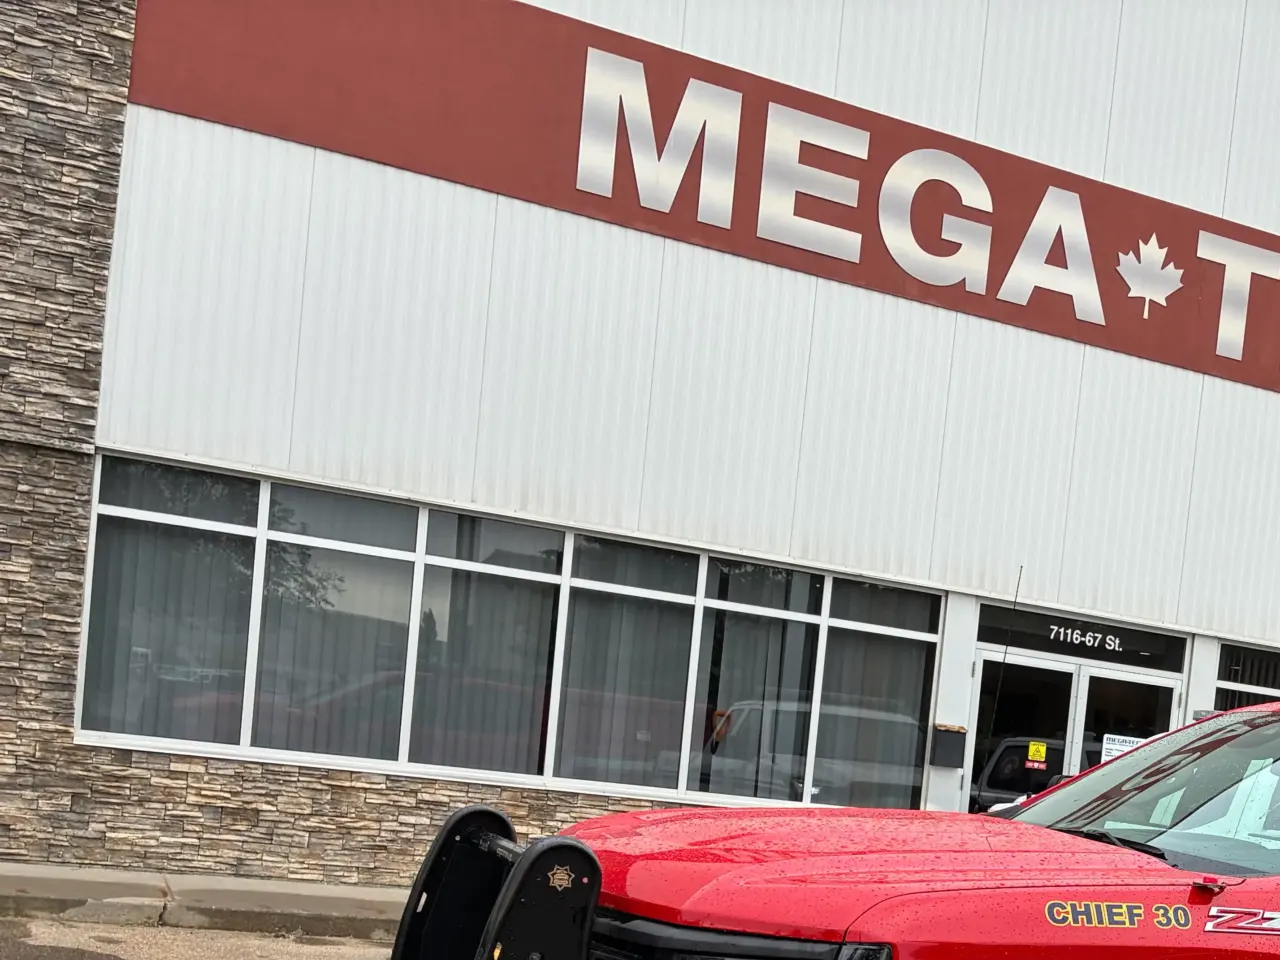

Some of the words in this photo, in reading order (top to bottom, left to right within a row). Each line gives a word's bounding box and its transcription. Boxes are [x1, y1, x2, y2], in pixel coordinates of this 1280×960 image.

[575, 46, 1106, 327] MEGA
[1050, 625, 1102, 647] 7116-67
[1105, 635, 1123, 651] St.
[1045, 901, 1144, 927] CHIEF
[1152, 904, 1191, 929] 30
